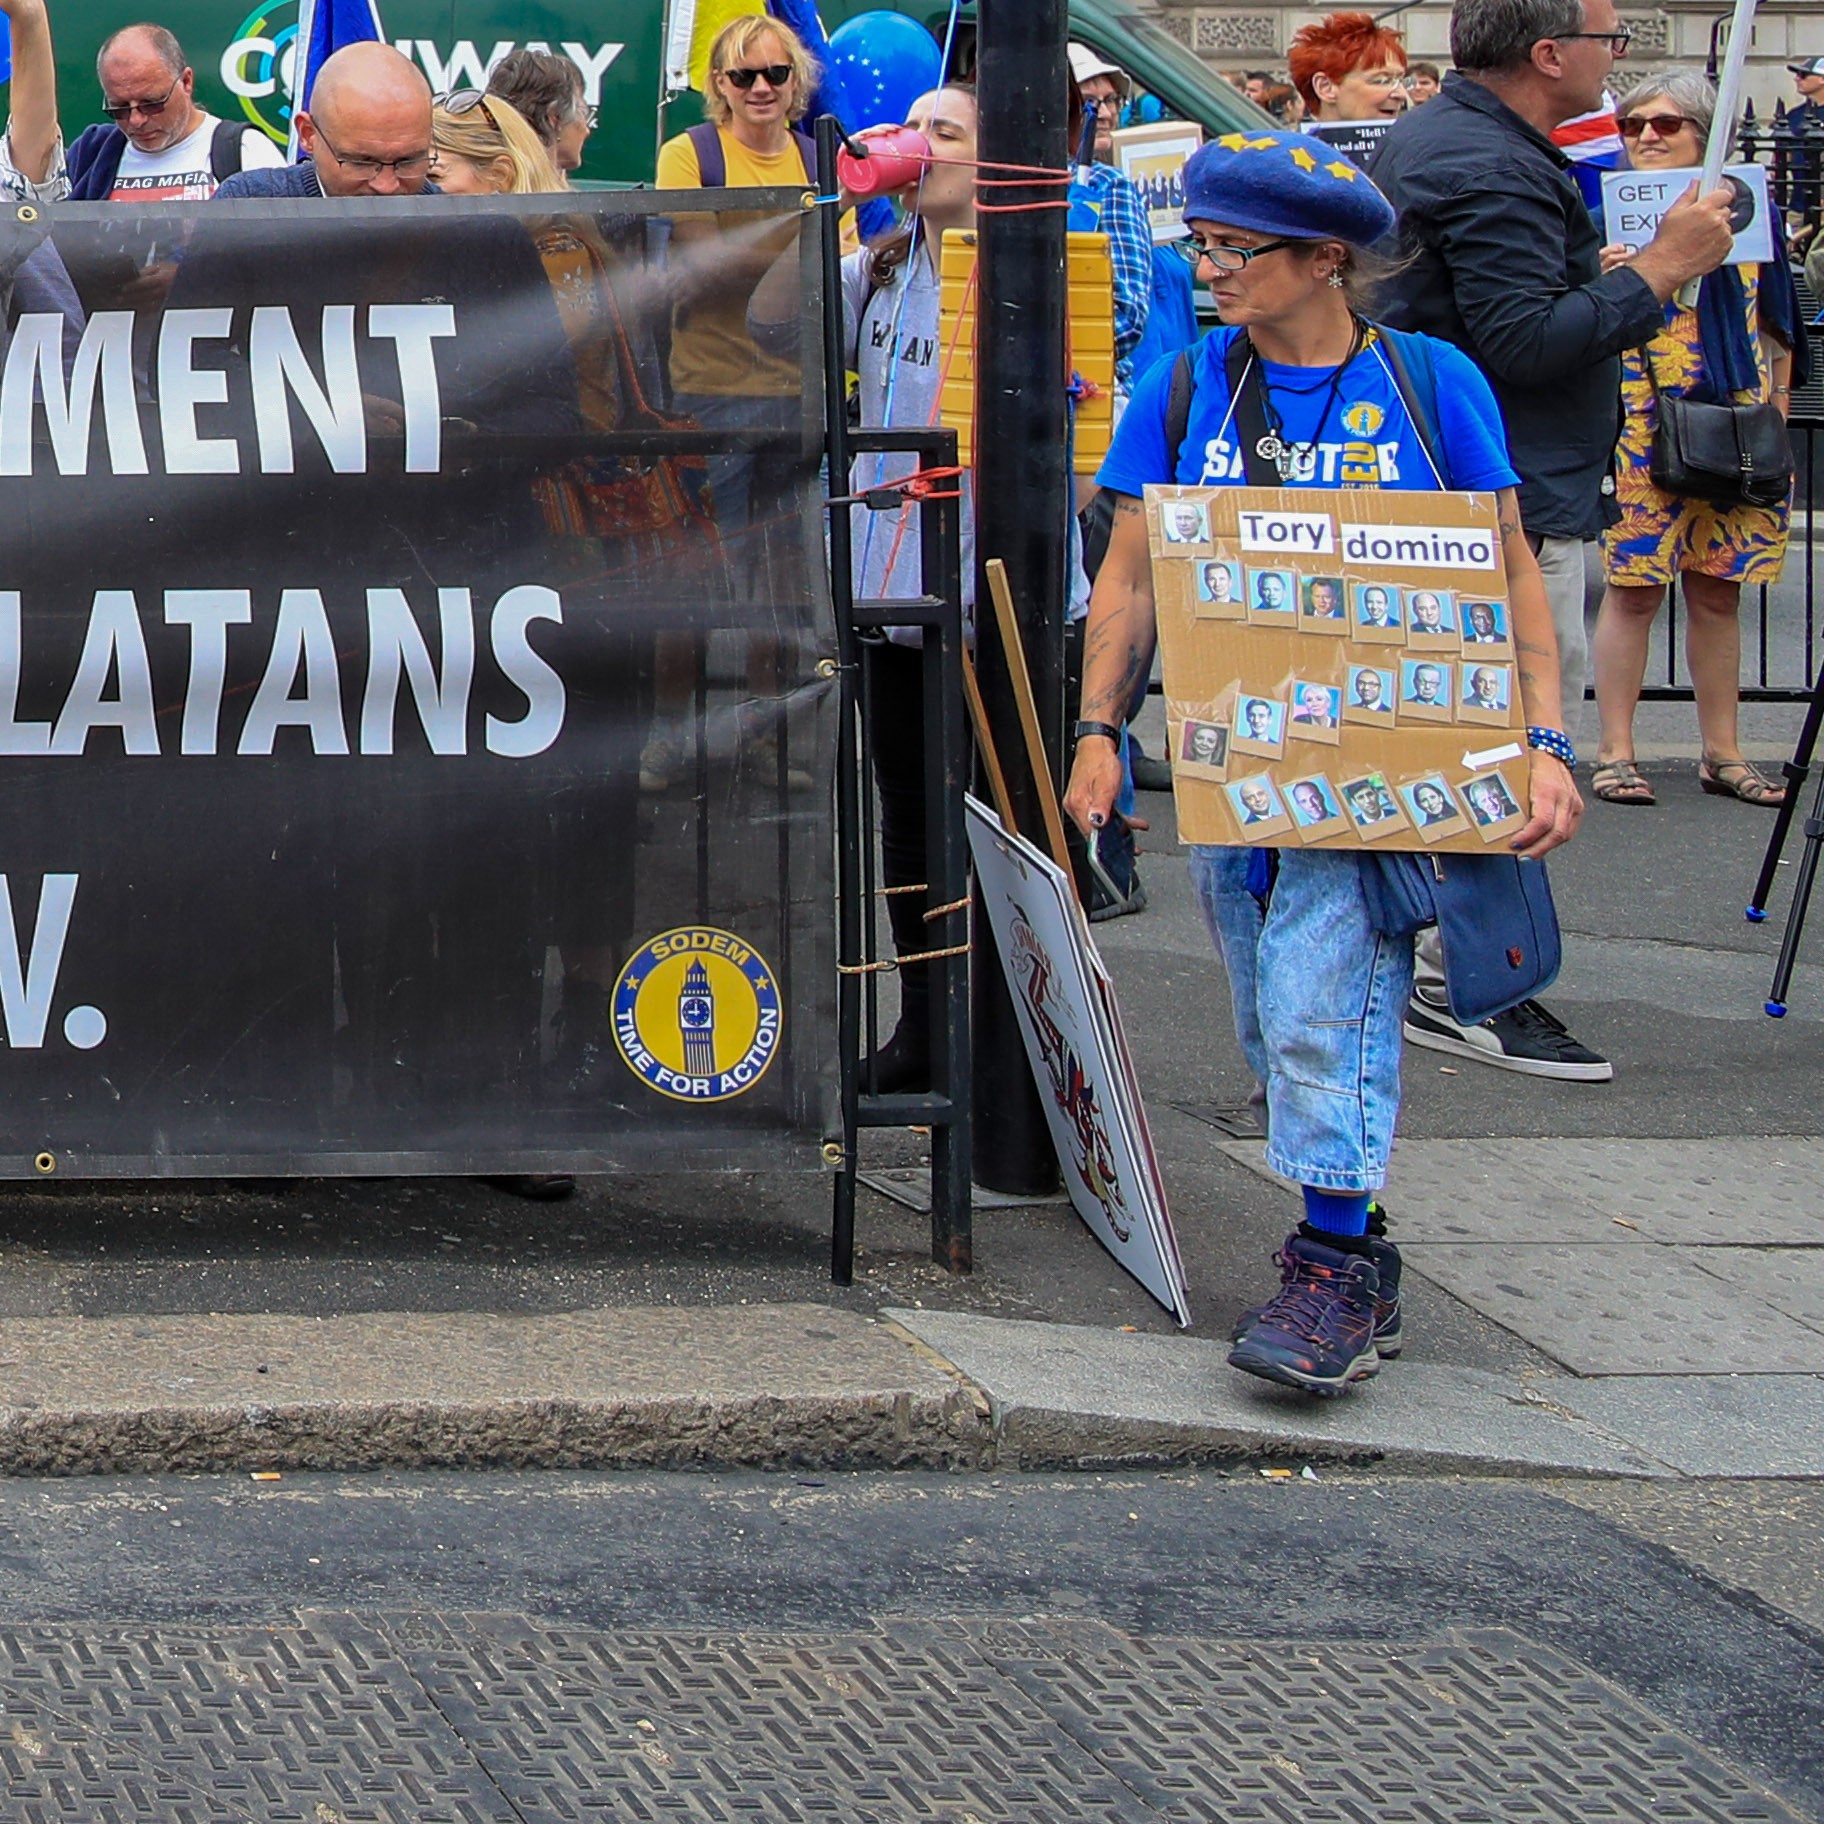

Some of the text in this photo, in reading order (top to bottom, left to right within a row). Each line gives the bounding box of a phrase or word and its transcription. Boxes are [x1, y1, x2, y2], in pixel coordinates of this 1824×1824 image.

[113, 173, 209, 189] FLAG MAFIA
[1618, 183, 1668, 202] GET
[1621, 213, 1664, 232] EXI
[1242, 515, 1490, 563] Tory domino
[650, 932, 751, 966] SODEM
[616, 1007, 778, 1096] TIME FOR ACTION
